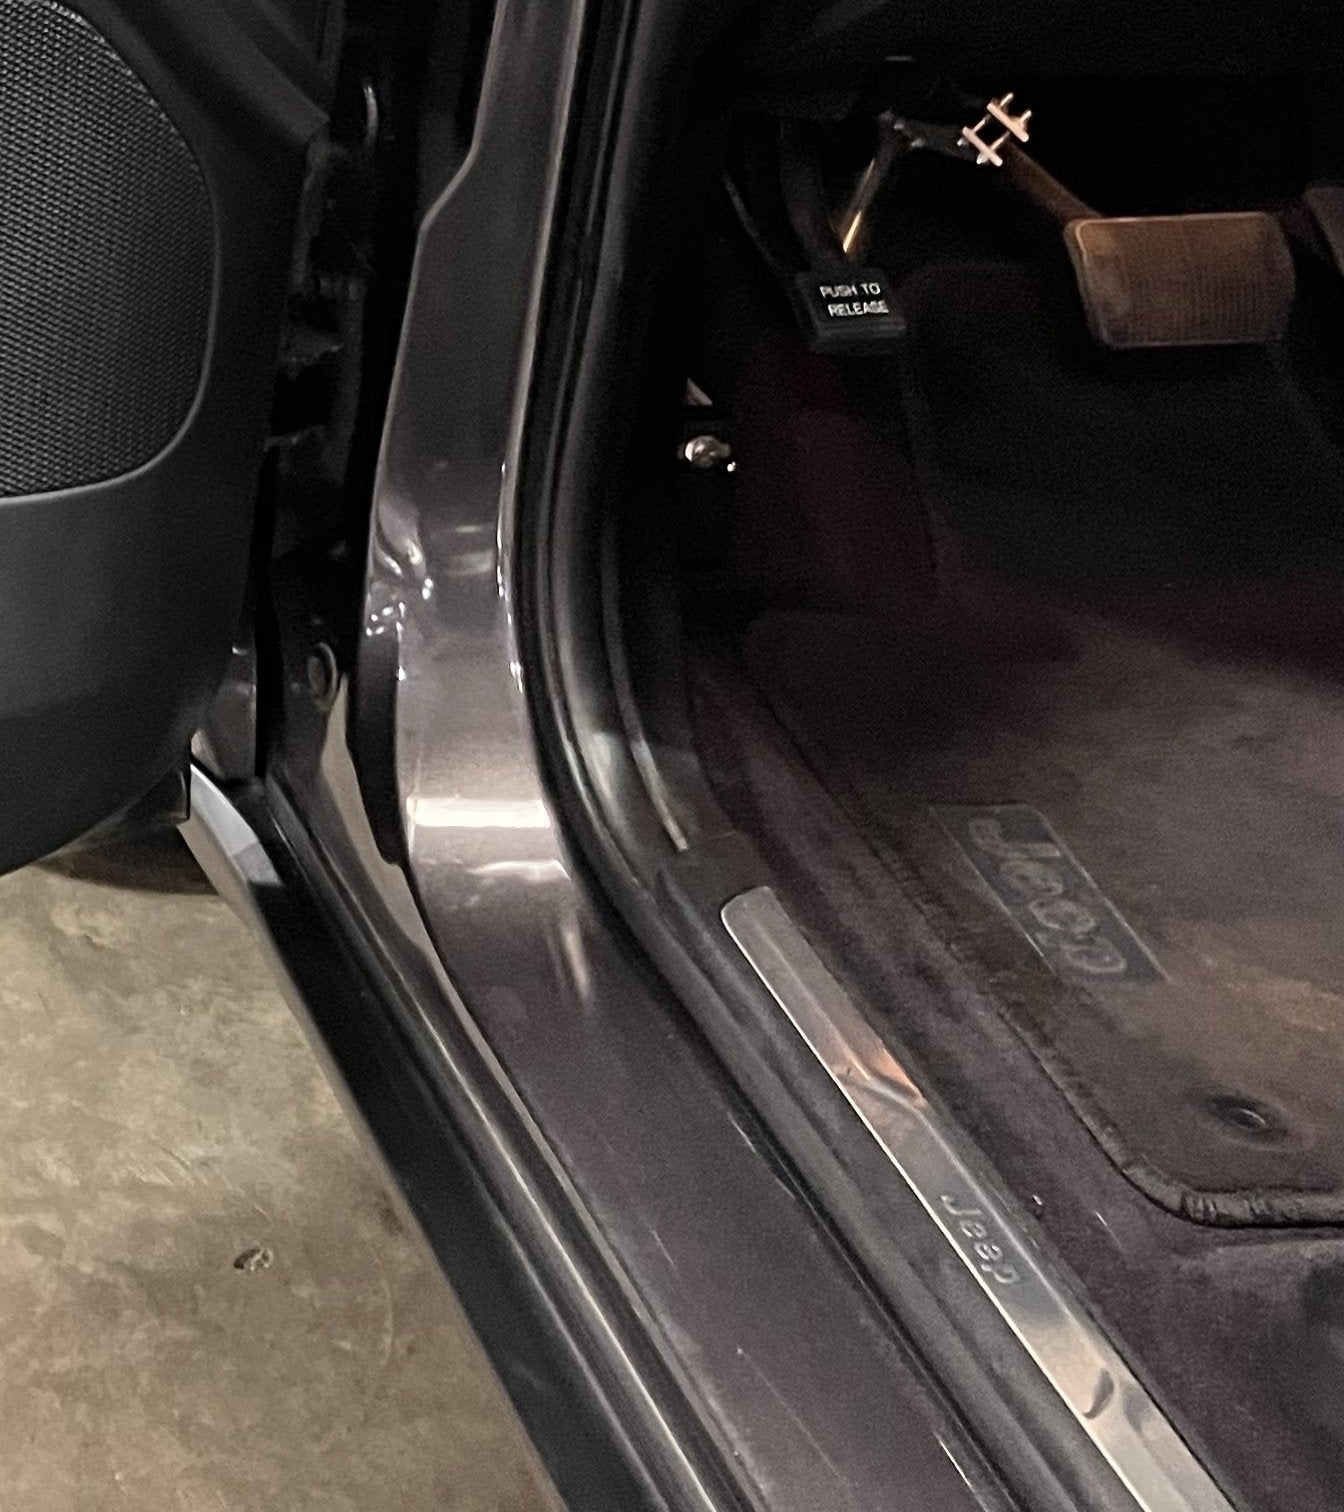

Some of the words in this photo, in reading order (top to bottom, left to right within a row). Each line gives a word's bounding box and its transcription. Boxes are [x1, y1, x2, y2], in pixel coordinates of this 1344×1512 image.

[819, 284, 859, 299] PUSH
[860, 282, 882, 296] TO
[827, 299, 890, 318] RELEASE
